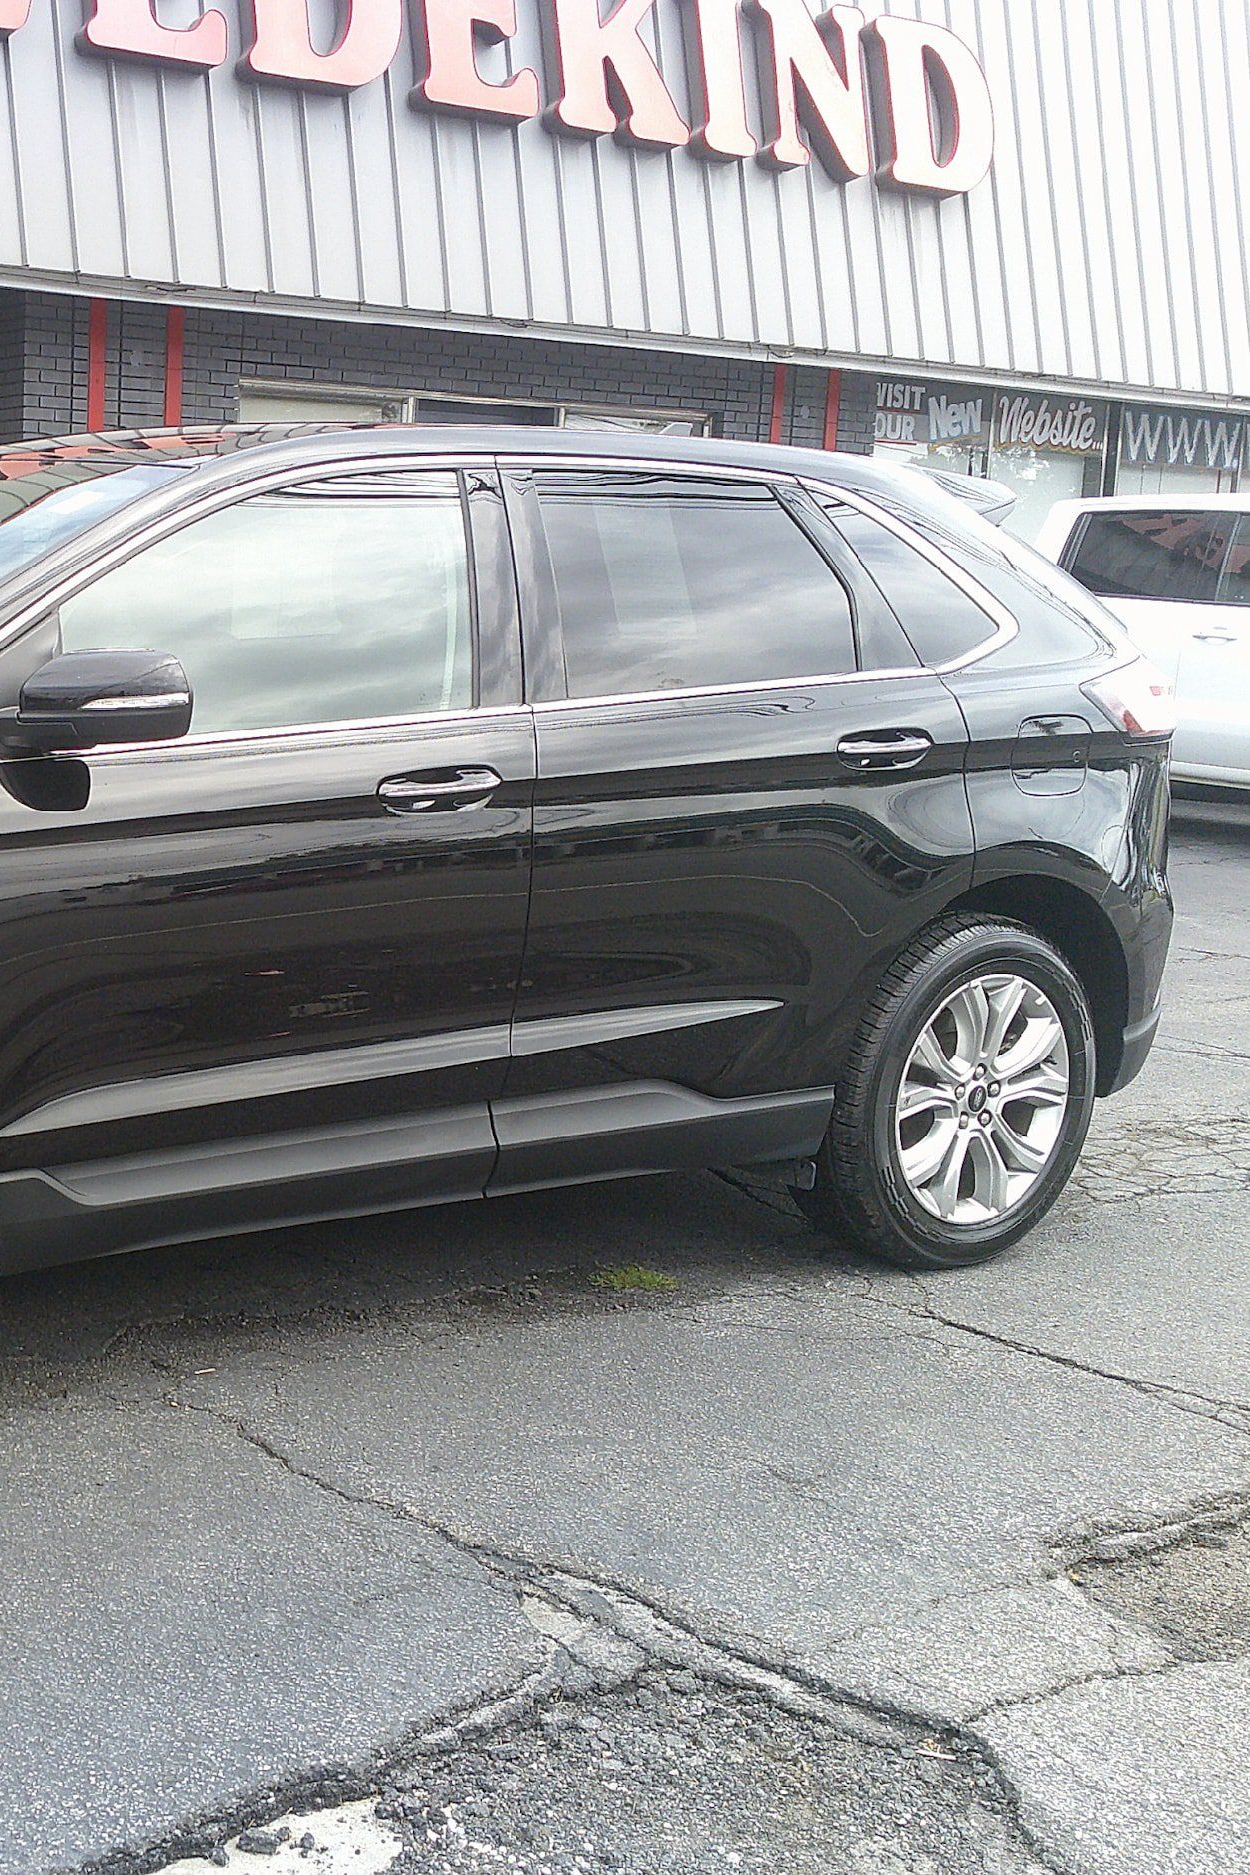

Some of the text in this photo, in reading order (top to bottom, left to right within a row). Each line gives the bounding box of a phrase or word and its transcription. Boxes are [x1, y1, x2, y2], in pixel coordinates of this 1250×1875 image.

[876, 382, 926, 411] VISIT
[873, 412, 916, 440] OUR
[927, 395, 982, 441] New
